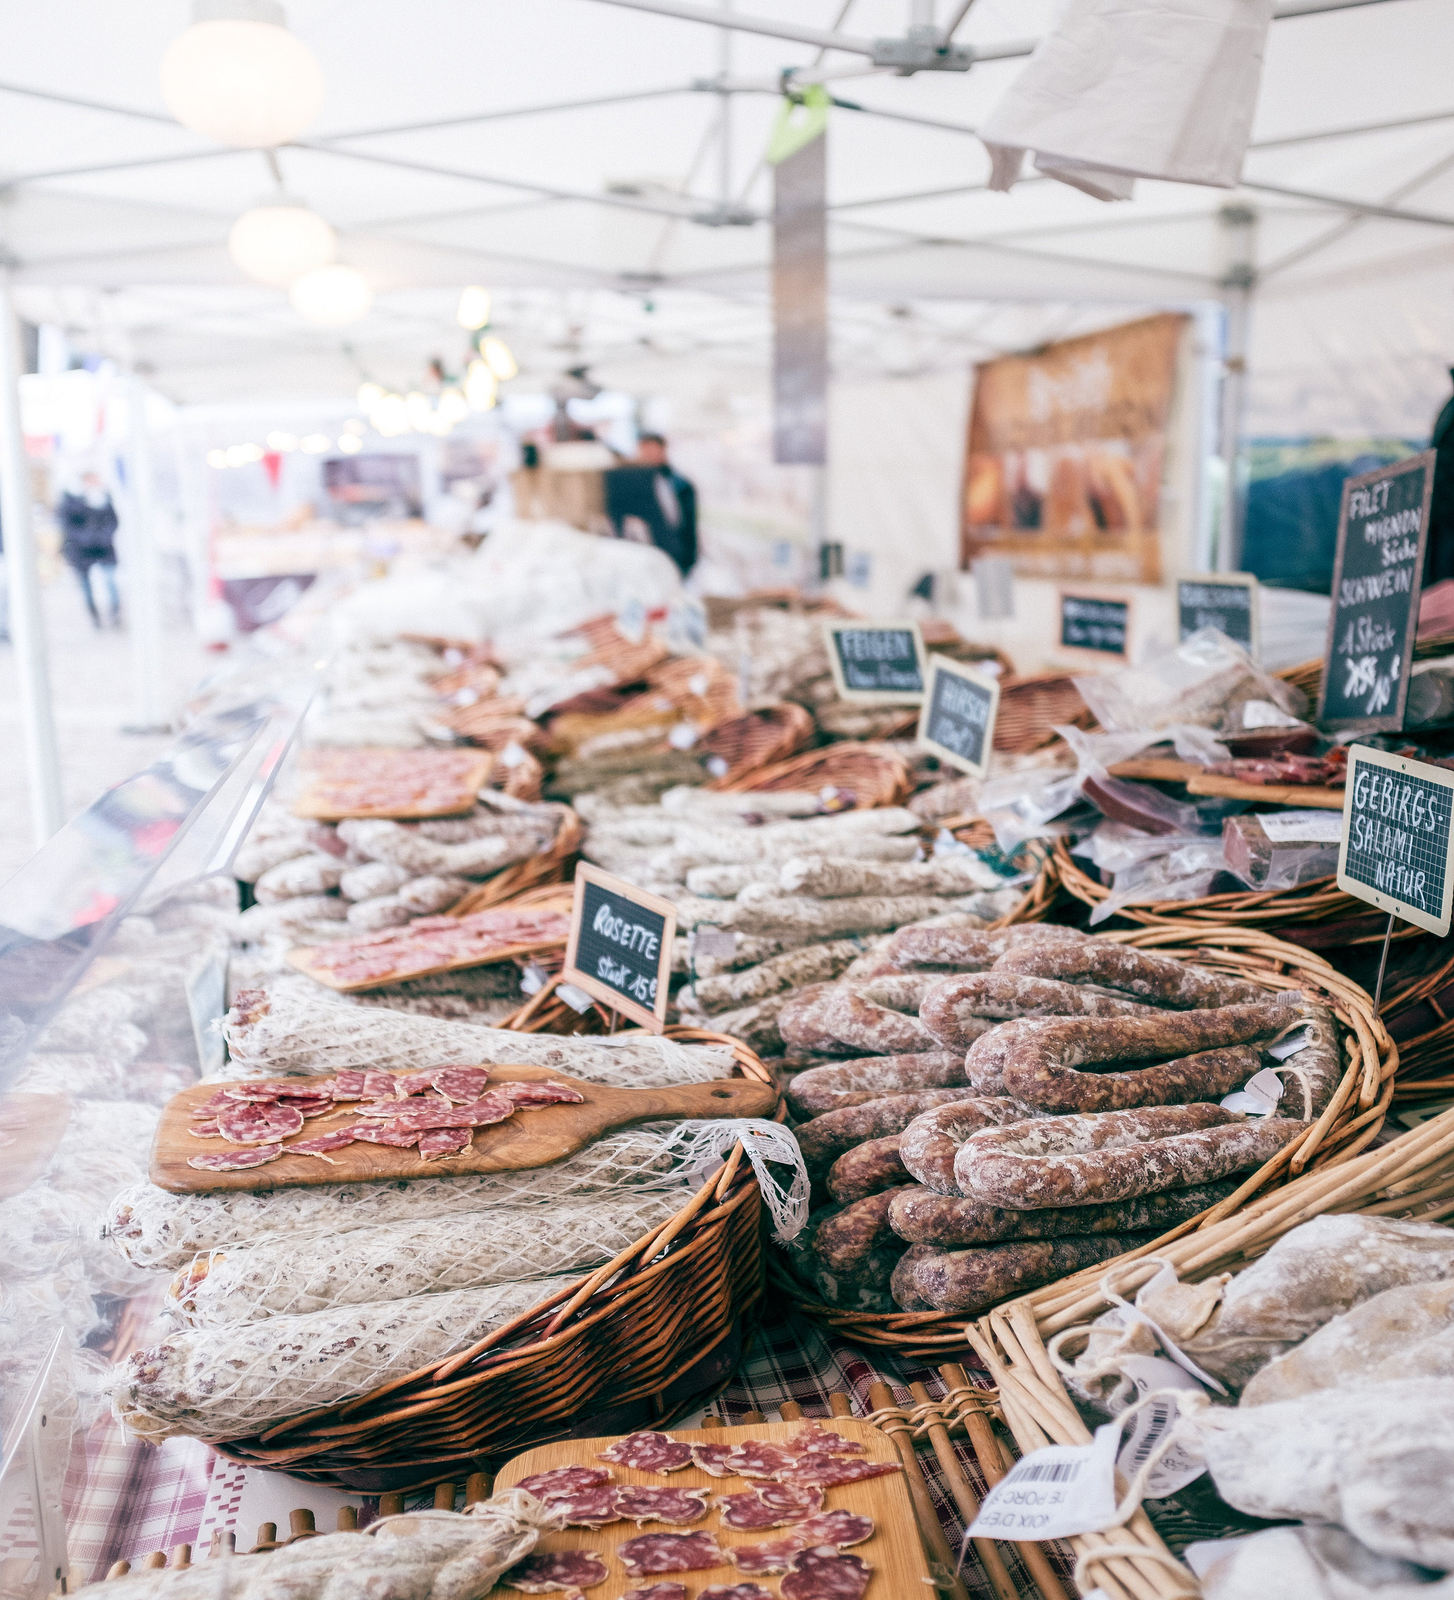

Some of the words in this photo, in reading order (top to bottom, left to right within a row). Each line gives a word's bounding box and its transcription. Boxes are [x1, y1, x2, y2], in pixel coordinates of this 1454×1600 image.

[1350, 479, 1394, 520] FILET
[1365, 506, 1422, 545] MIGNON
[1340, 566, 1413, 608] SCHWEIN
[1353, 814, 1414, 864] SALAMI
[1375, 859, 1426, 910] NATUR
[593, 903, 660, 960] ROSETTE
